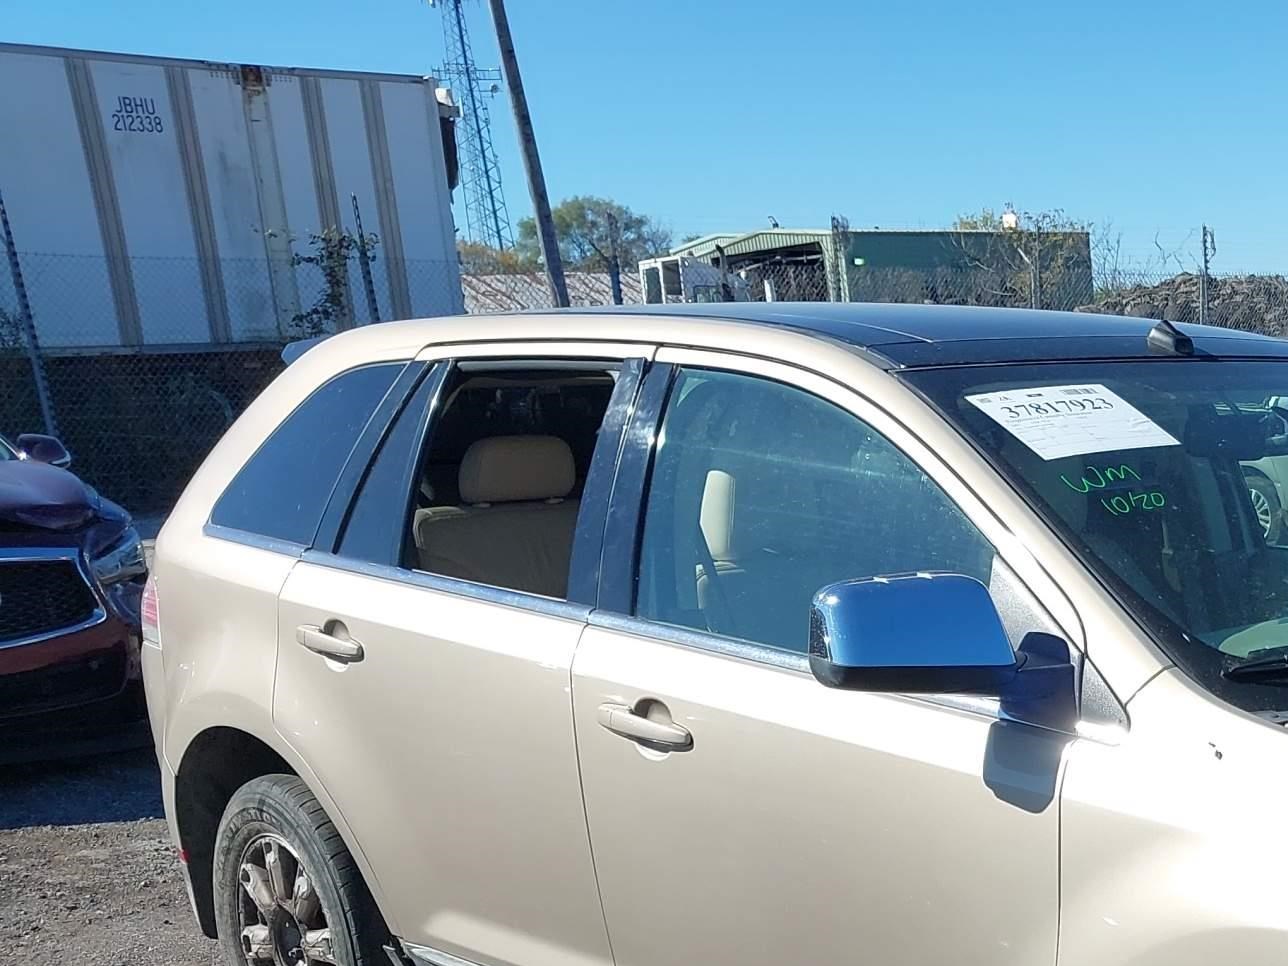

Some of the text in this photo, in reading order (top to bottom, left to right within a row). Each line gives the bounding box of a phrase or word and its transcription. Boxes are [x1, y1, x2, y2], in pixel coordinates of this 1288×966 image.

[115, 96, 157, 115] JBHU
[111, 114, 164, 133] 212338
[1000, 397, 1114, 419] 37817923
[1100, 491, 1166, 516] 10/20
